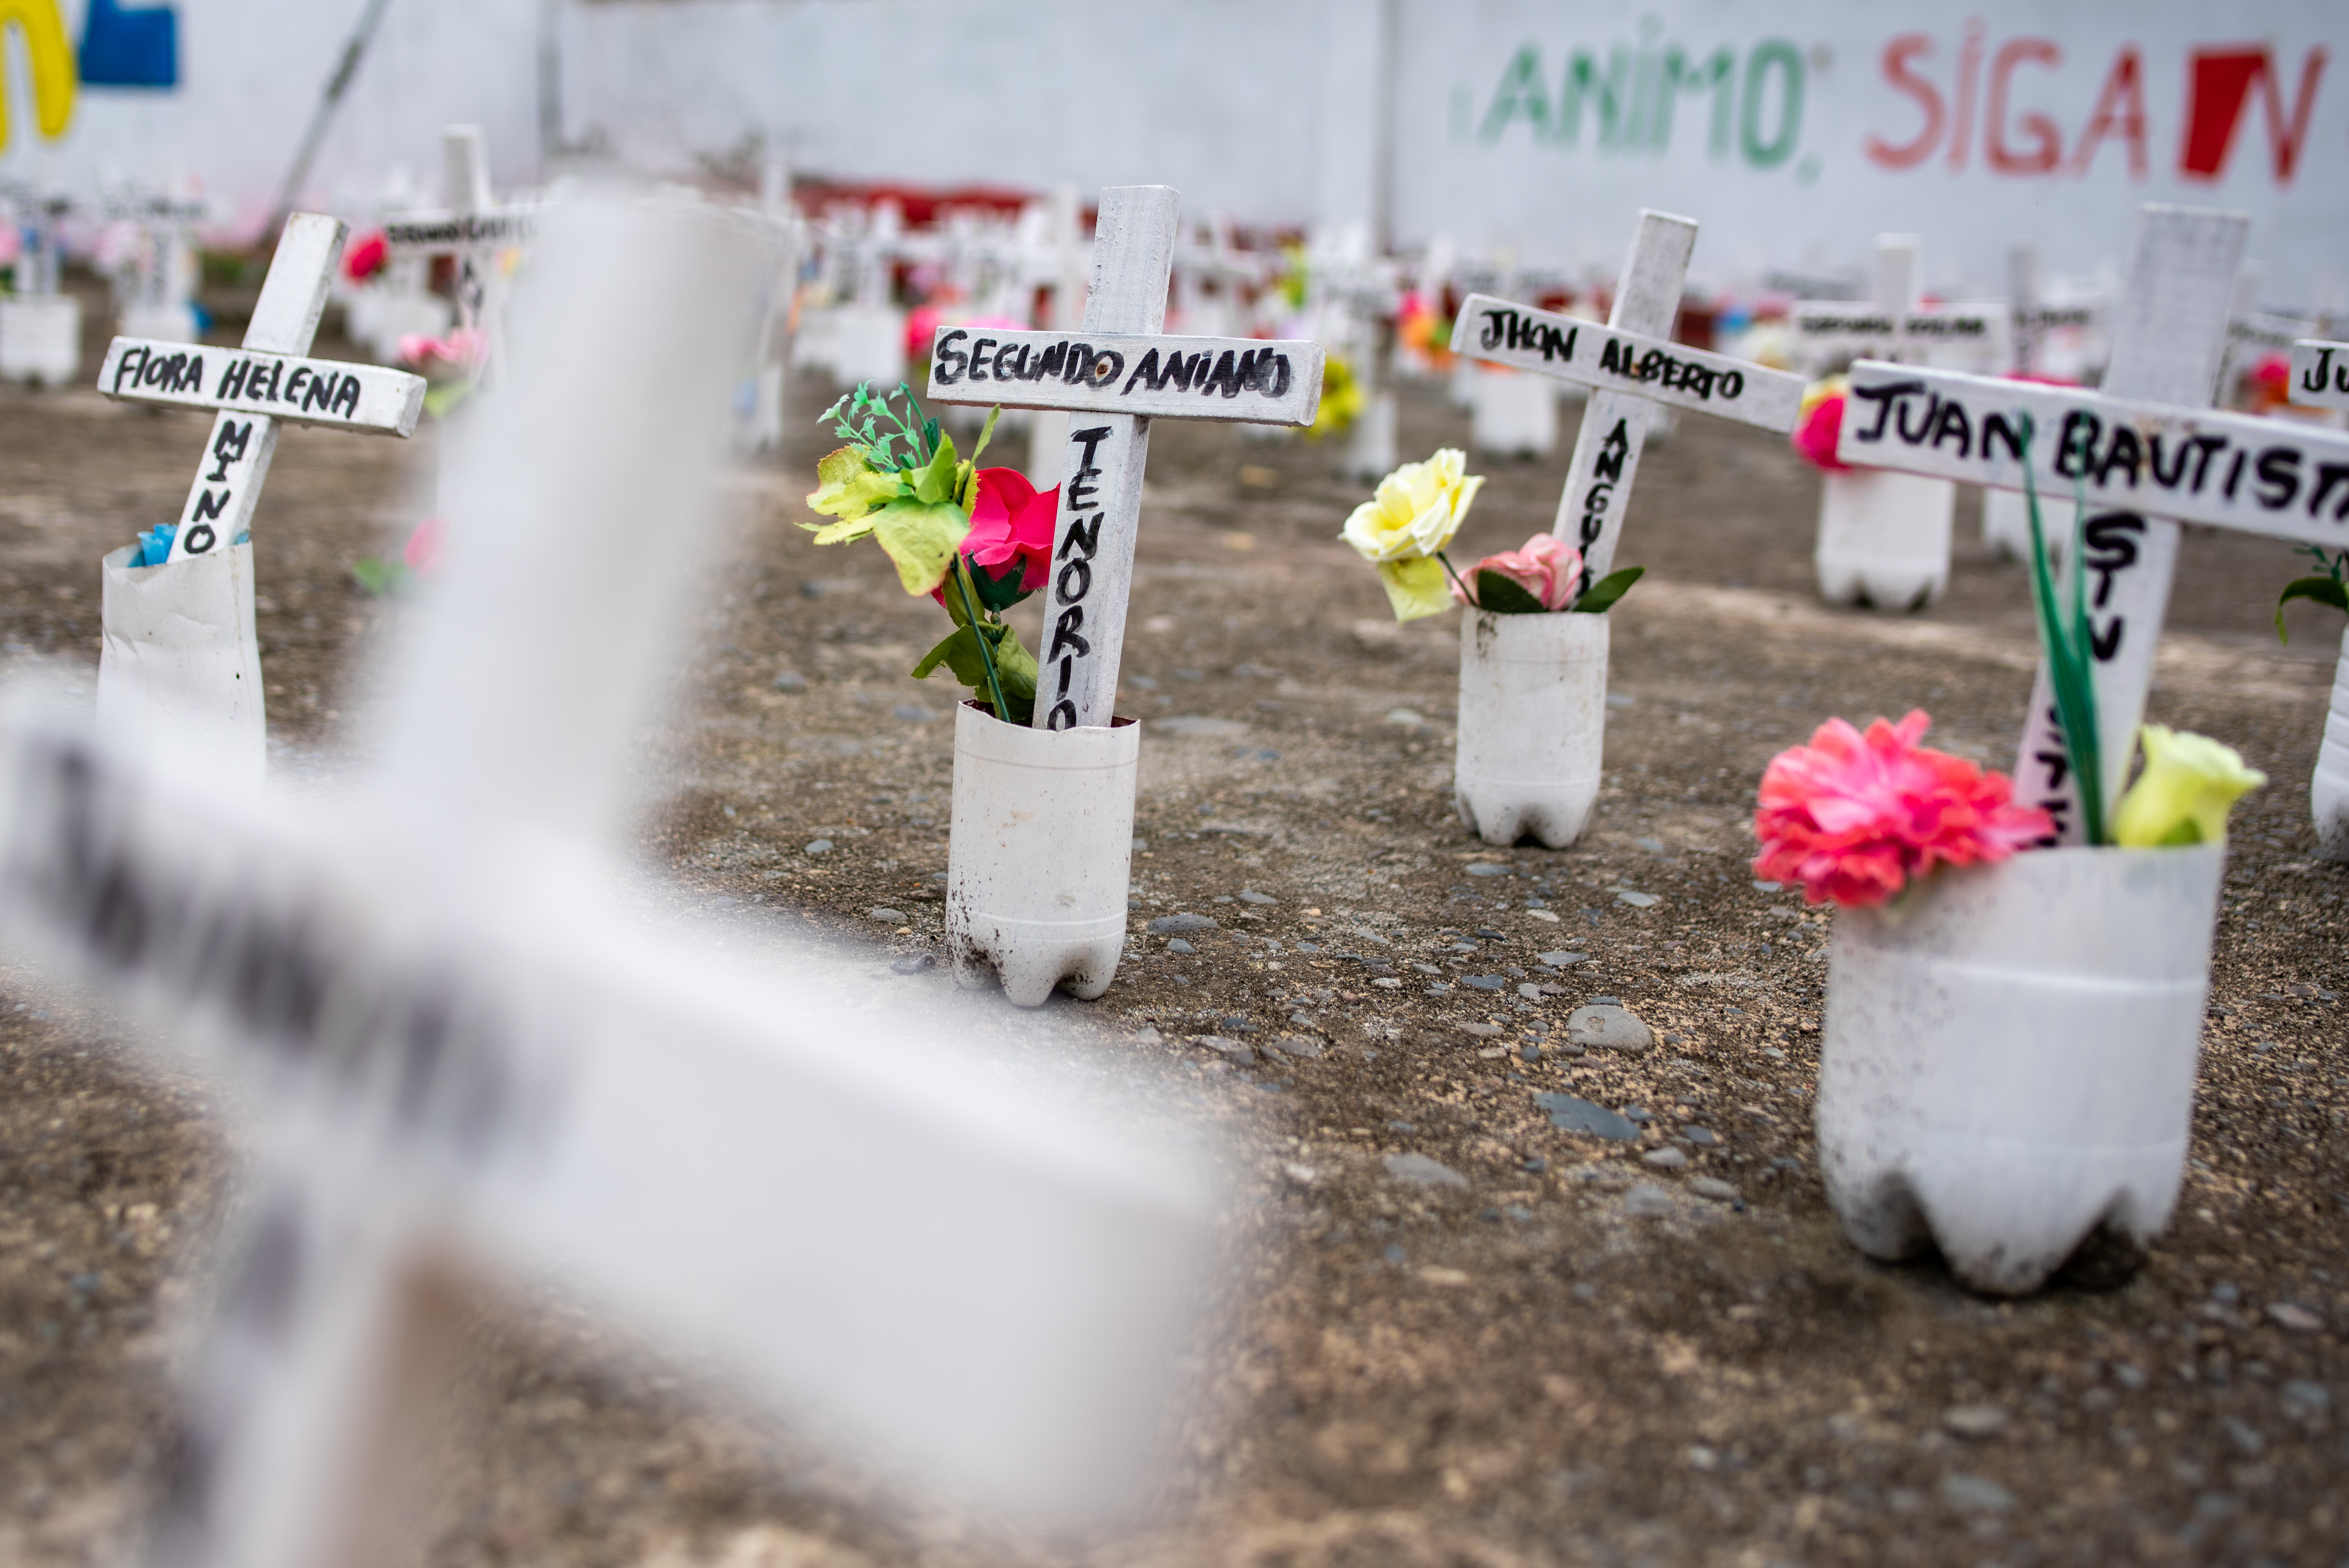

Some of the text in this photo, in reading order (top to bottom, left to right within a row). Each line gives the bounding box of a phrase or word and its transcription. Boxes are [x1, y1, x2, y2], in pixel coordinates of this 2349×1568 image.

[216, 359, 361, 419] HELENA
[934, 329, 1125, 388] SEGUNDO
[1480, 309, 1745, 400] JHON ALBERTO
[183, 419, 253, 554] MINO
[1854, 379, 2349, 523] JUAN BAUTIST
[1047, 425, 1113, 732] TENORIO
